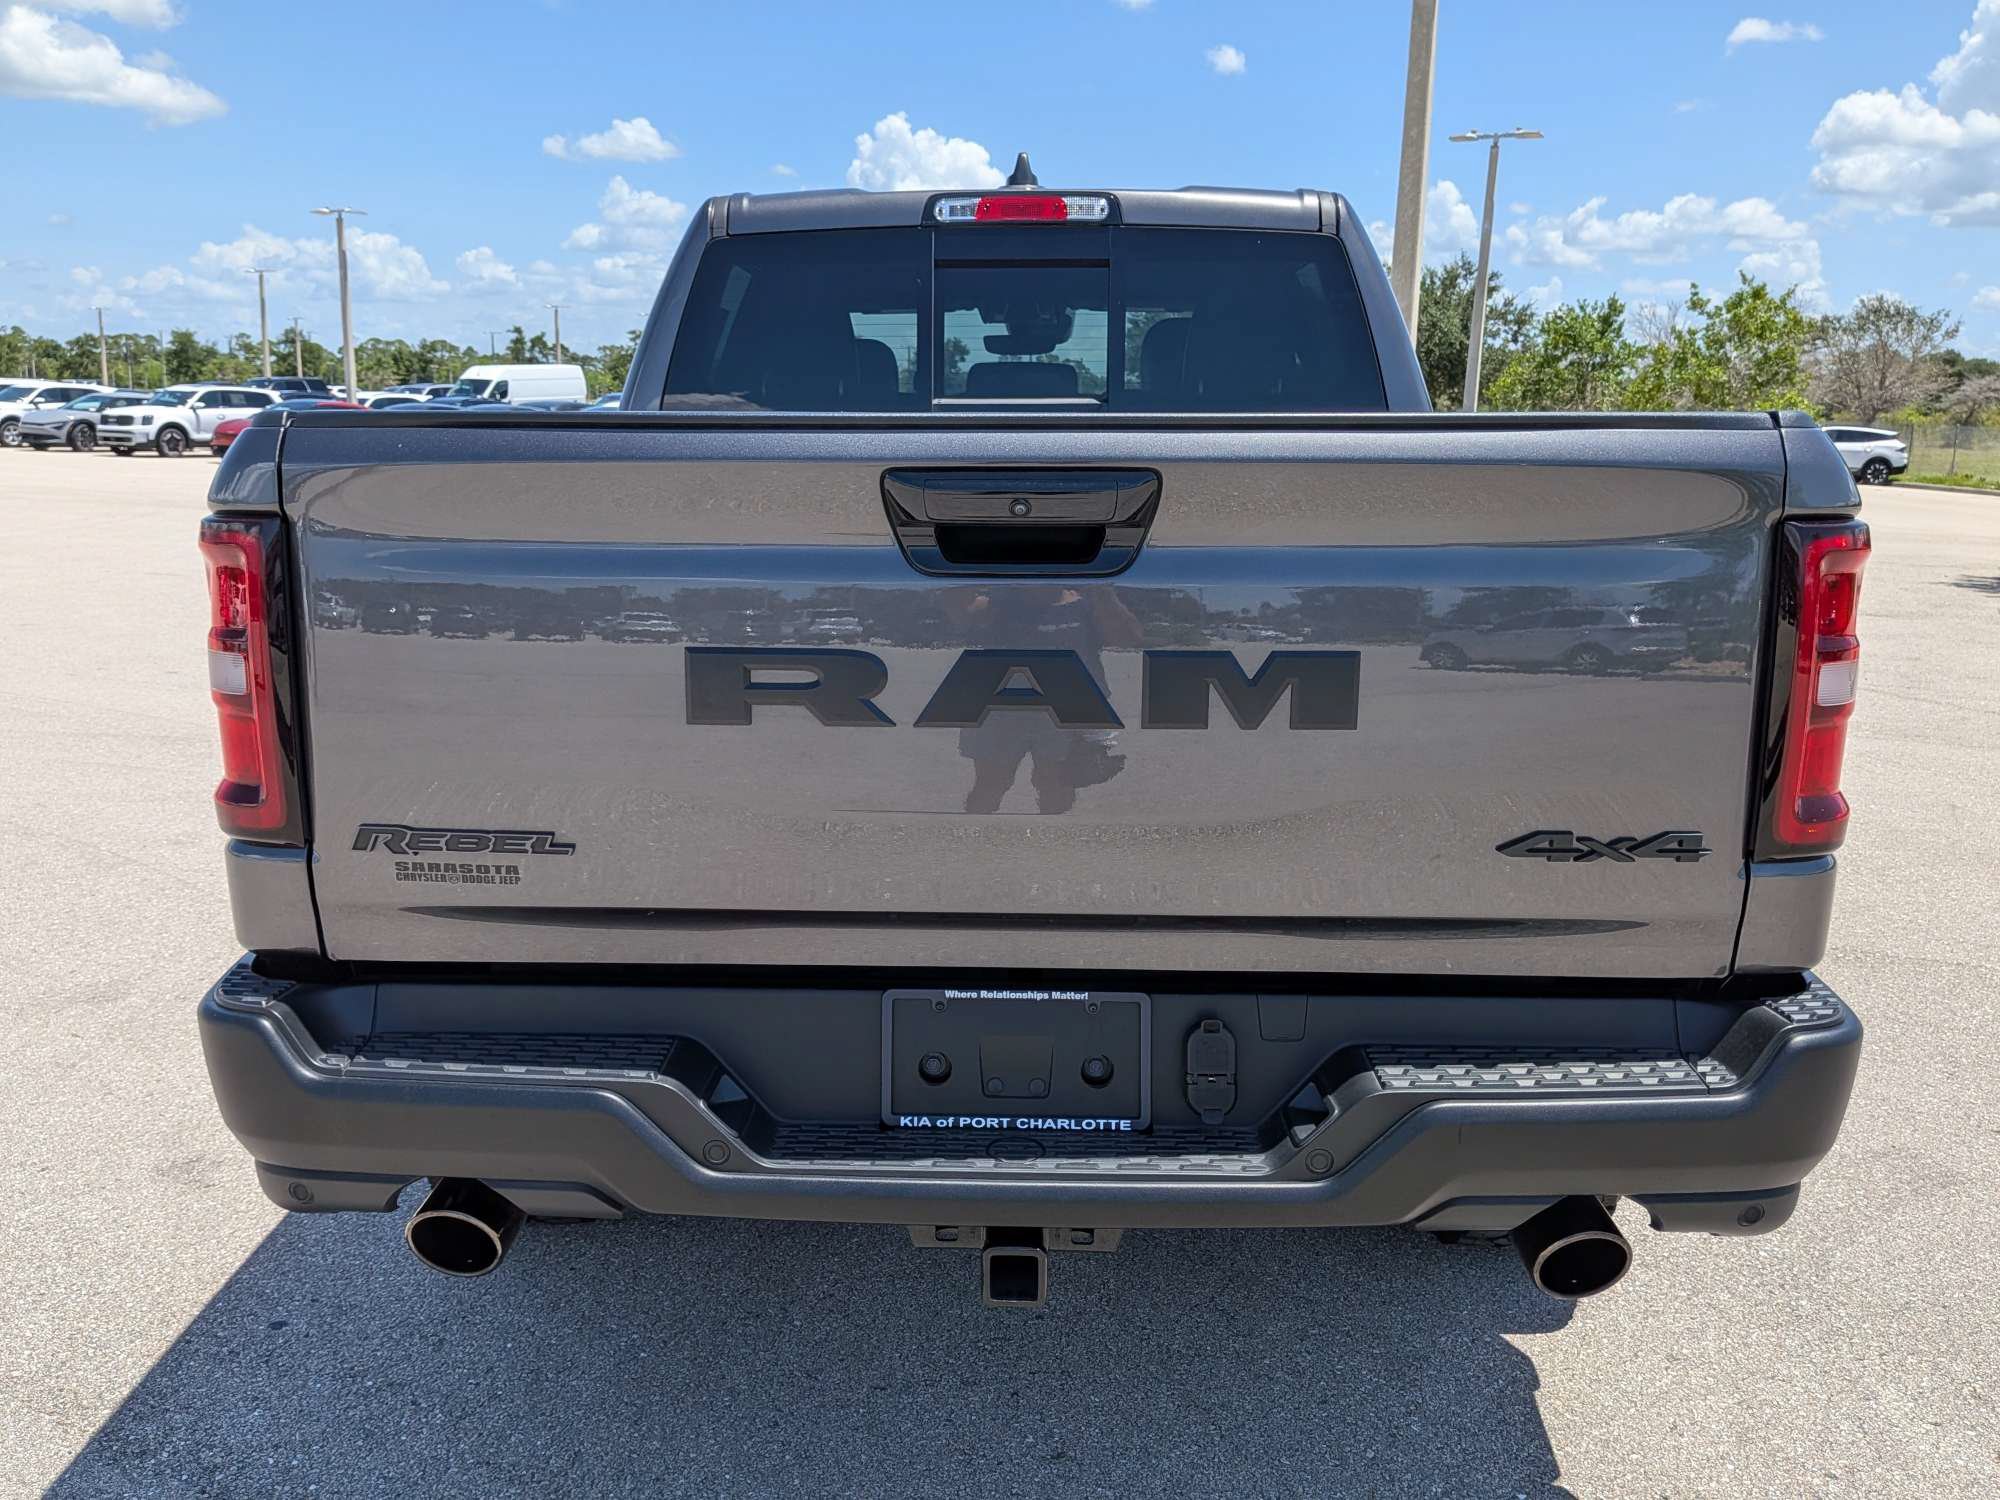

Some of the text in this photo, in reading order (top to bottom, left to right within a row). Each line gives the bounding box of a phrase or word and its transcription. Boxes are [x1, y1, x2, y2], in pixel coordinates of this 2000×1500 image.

[684, 646, 1362, 730] RAM
[352, 823, 577, 856] REBEL
[394, 861, 521, 876] SARASOTA
[395, 871, 521, 885] CHRYSLER DODGE JEEP
[944, 989, 1089, 1001] Where Relationships Matter!
[899, 1116, 1132, 1131] KIA of PORT CHARLOTTE
